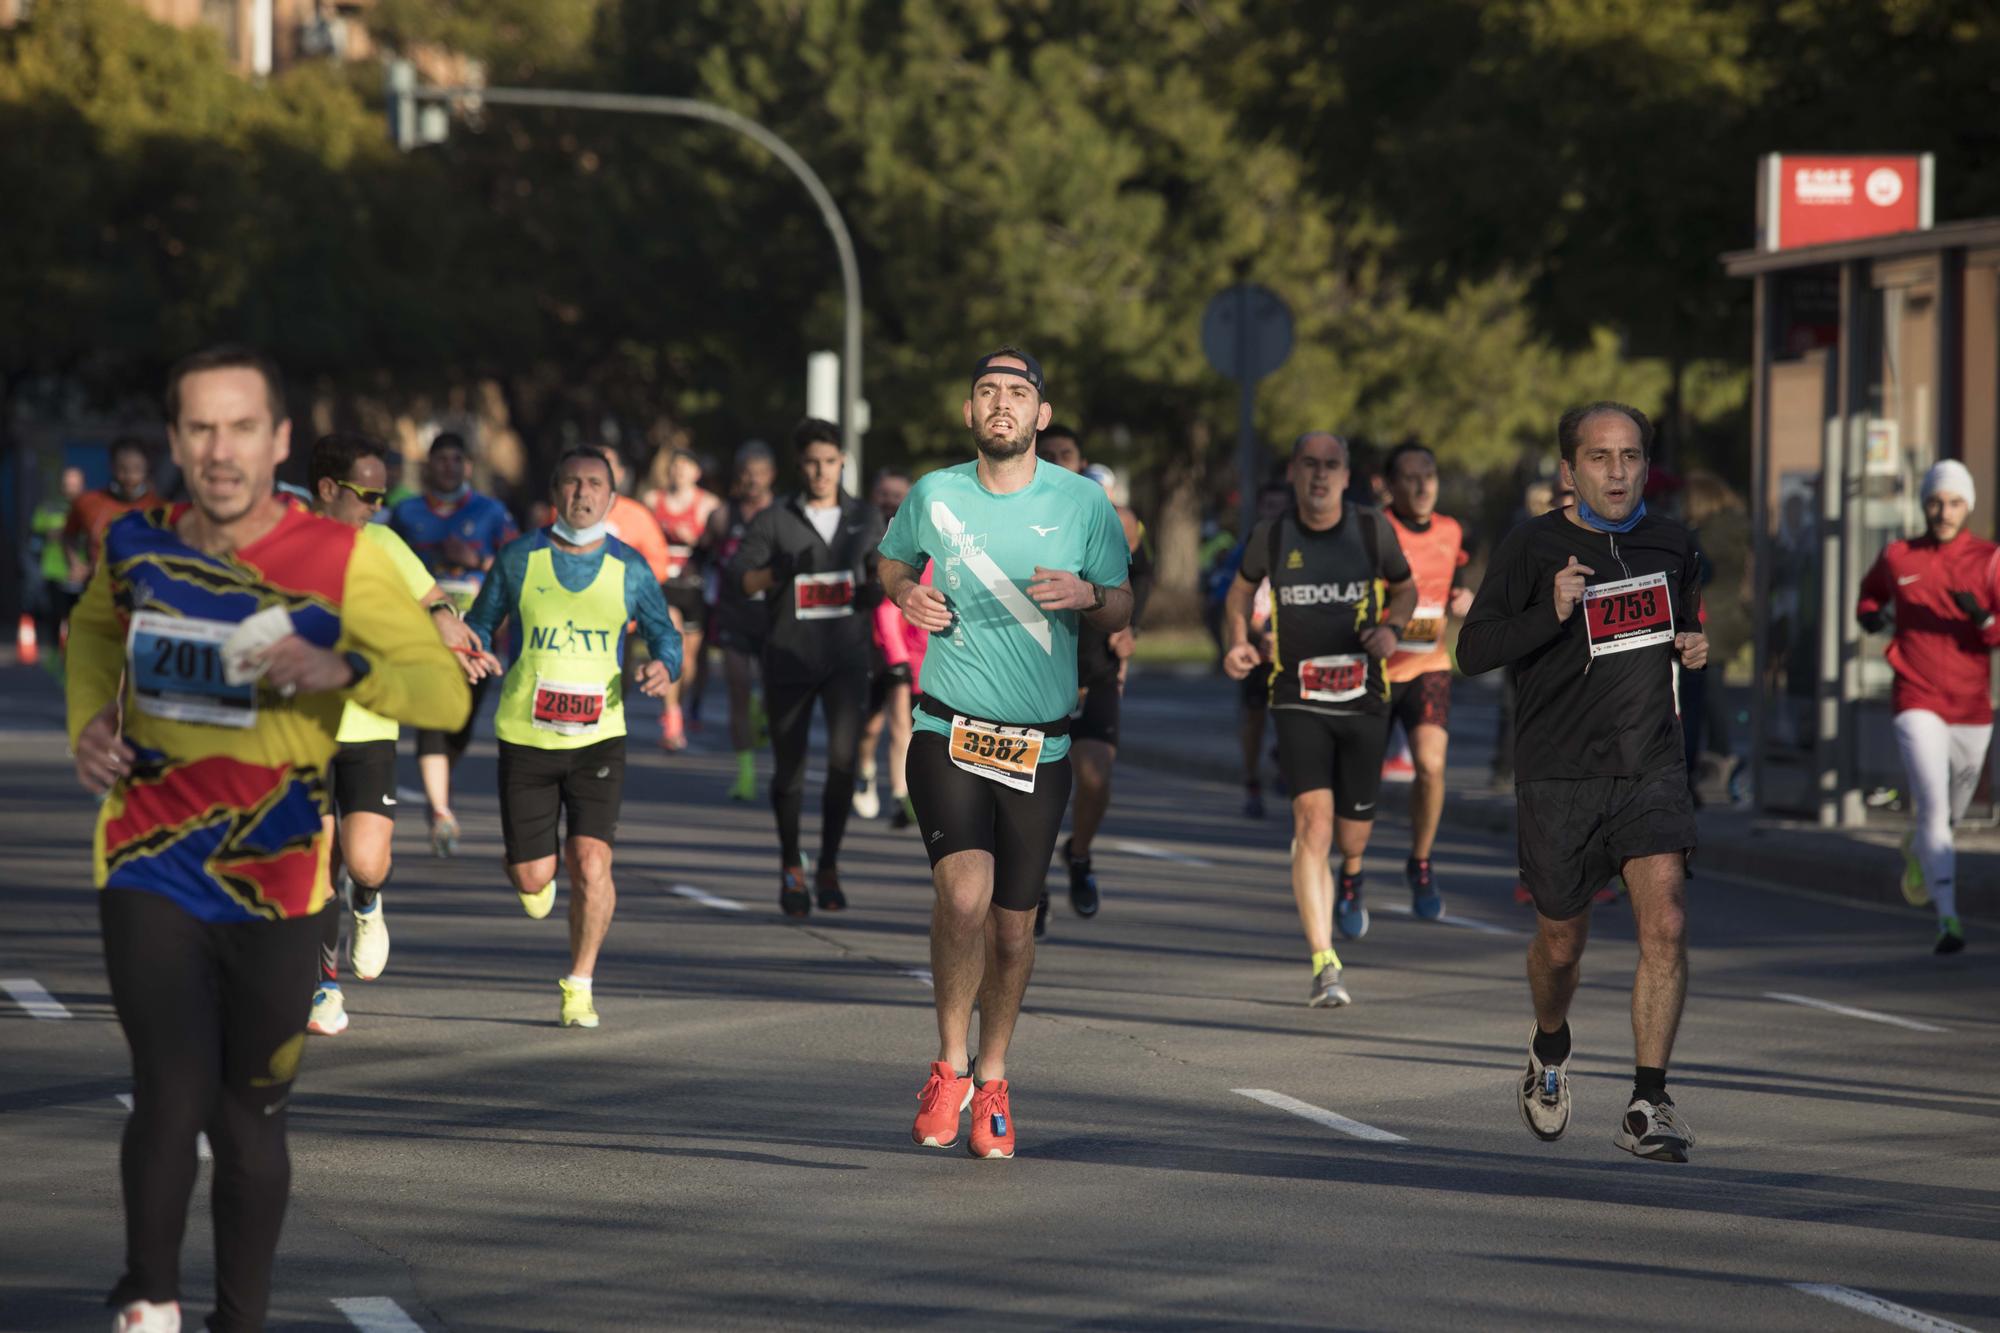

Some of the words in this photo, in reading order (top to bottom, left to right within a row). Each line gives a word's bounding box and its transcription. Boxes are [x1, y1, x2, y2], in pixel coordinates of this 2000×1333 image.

[951, 534, 974, 546] RUN
[1600, 590, 1657, 625] 2753
[154, 637, 227, 684] 201
[543, 691, 596, 716] 2850
[963, 731, 1029, 764] 3382
